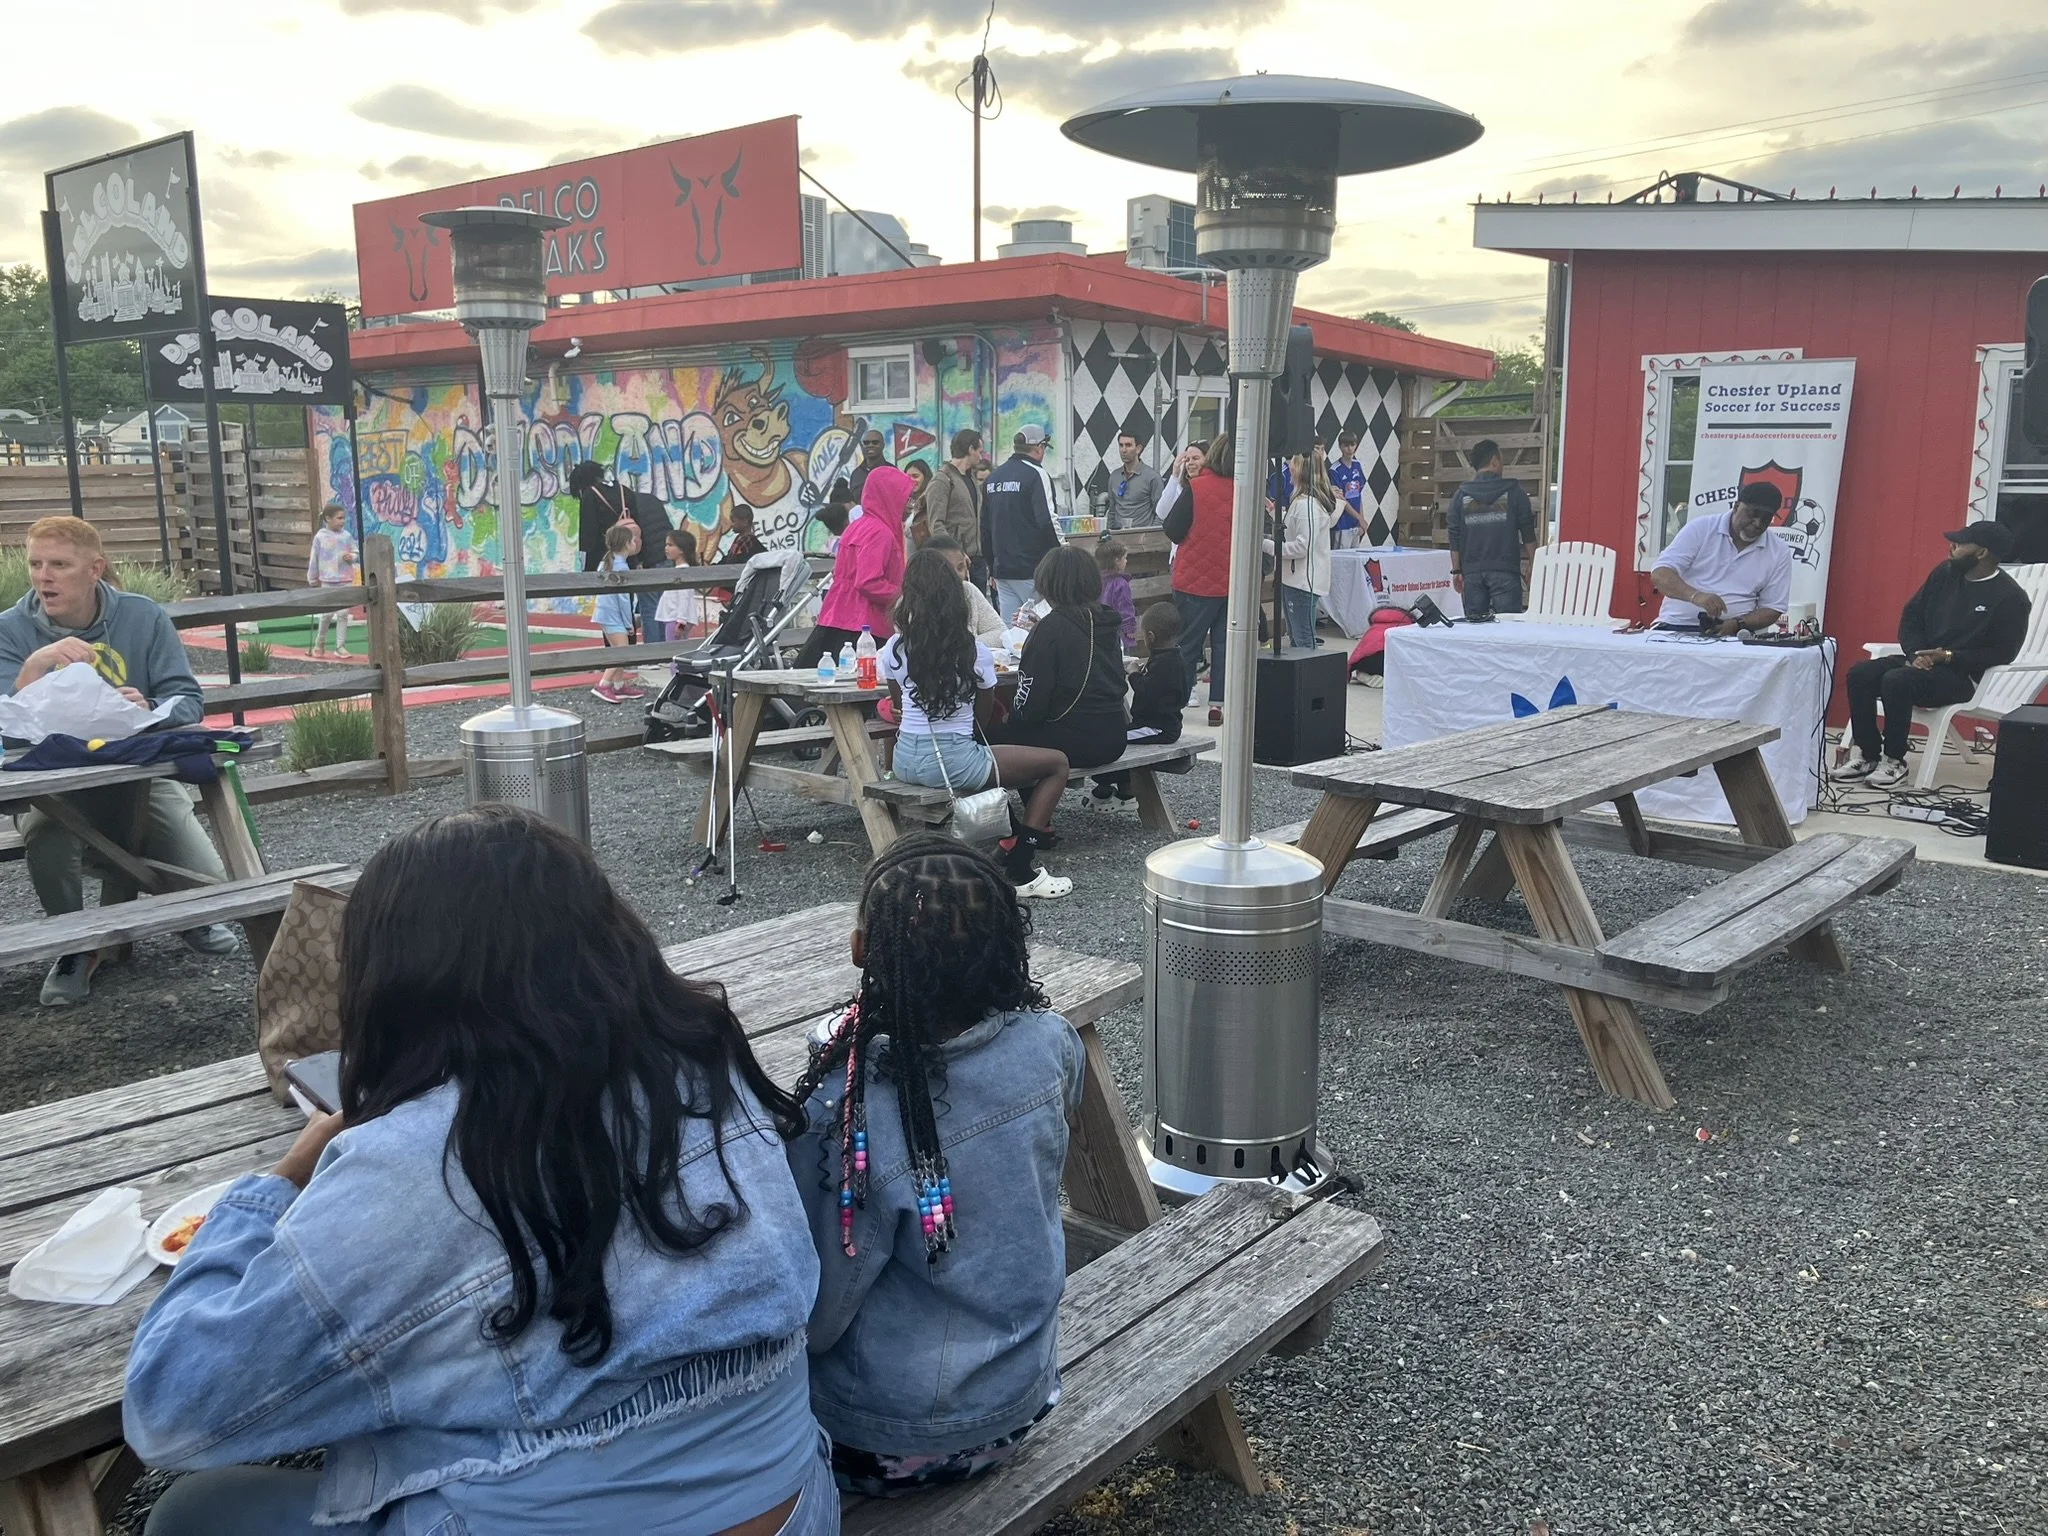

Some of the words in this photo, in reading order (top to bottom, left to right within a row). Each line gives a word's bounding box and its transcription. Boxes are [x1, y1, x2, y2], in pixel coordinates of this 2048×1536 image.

[65, 172, 189, 284] DELCOLAND
[160, 308, 333, 372] DECOLAND
[1707, 385, 1771, 397] Chester
[1777, 383, 1842, 398] Upland
[1704, 402, 1751, 412] Soccer
[1754, 402, 1776, 412] for
[1780, 401, 1841, 412] Success
[1694, 485, 1738, 506] CHES
[752, 511, 799, 537] ELCO
[1777, 532, 1805, 544] POWER
